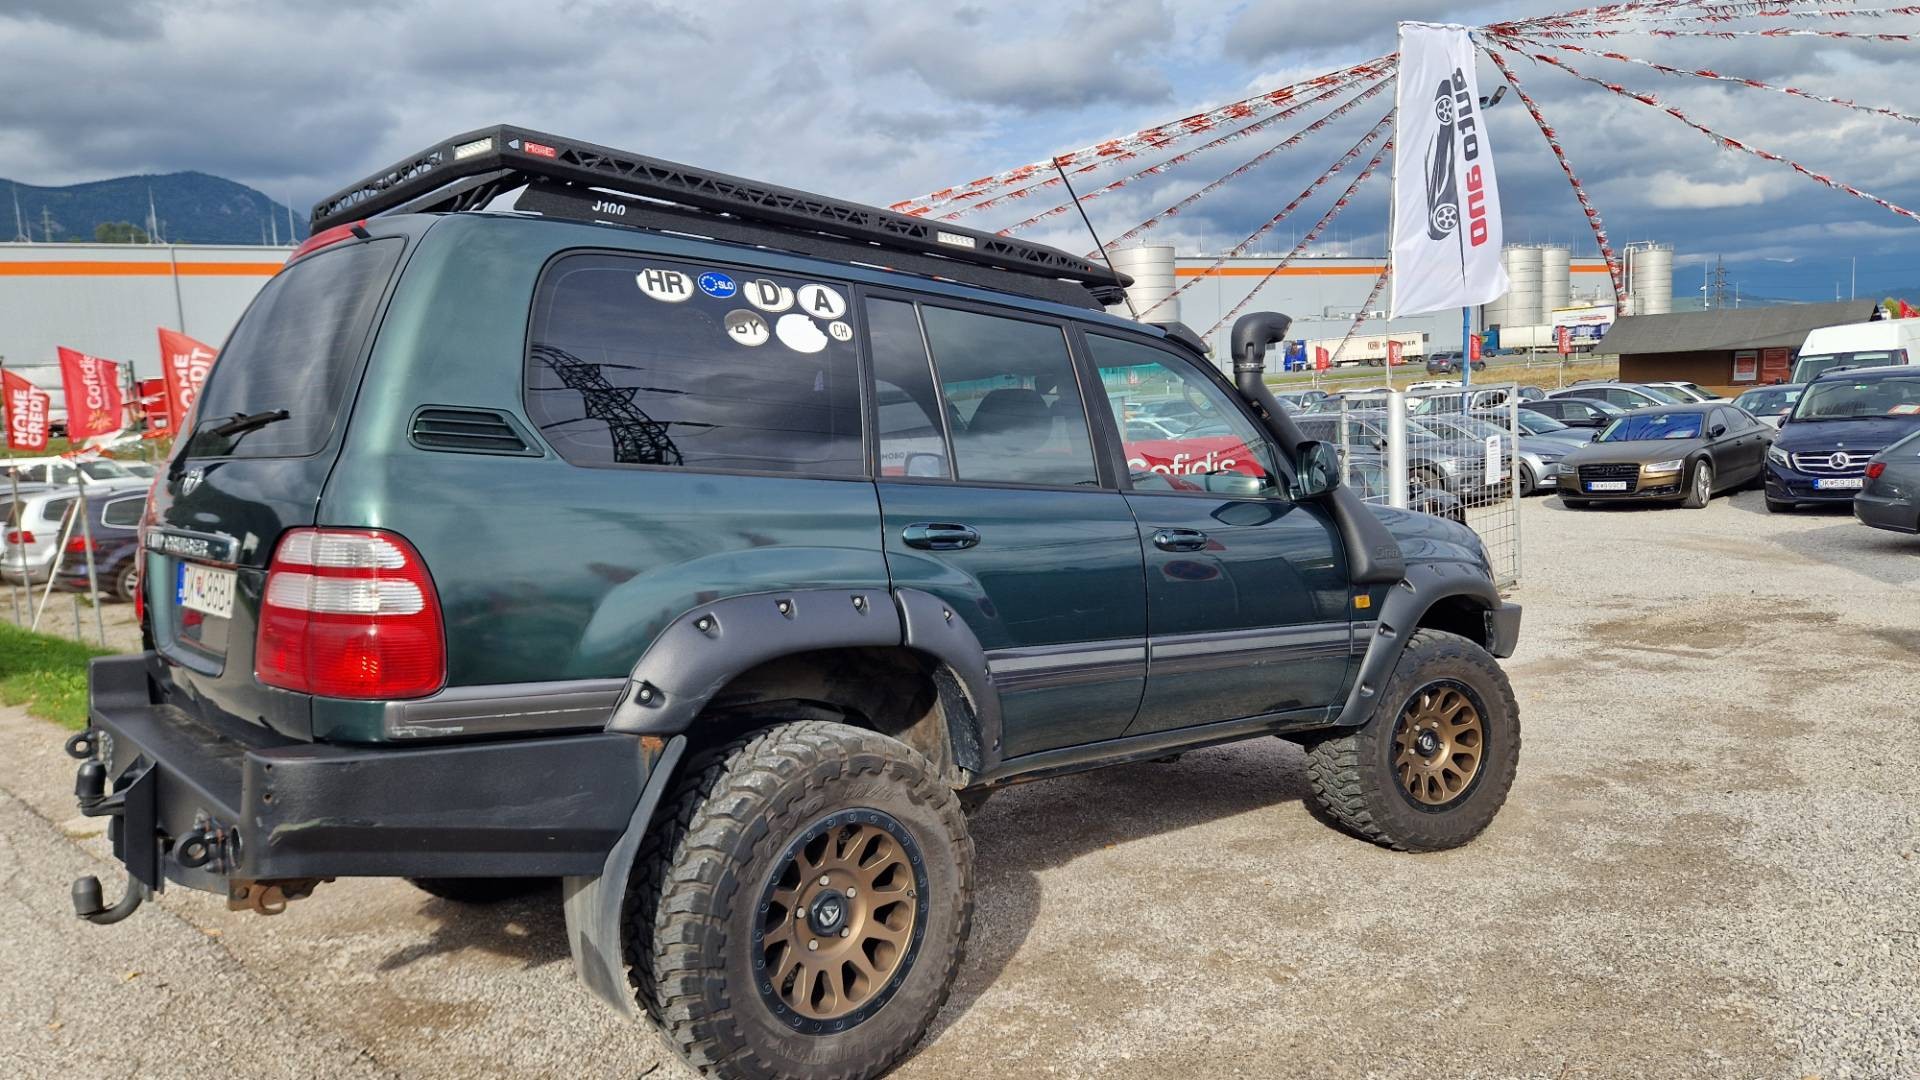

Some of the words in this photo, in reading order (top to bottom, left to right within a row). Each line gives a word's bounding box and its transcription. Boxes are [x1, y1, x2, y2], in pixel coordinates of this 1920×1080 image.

[592, 200, 626, 216] J100
[645, 270, 686, 295] HR
[717, 279, 734, 291] SLO
[757, 280, 781, 306] D
[814, 288, 835, 313] A
[833, 323, 848, 338] CH
[173, 353, 196, 418] OME
[13, 388, 28, 446] HOME
[28, 385, 48, 447] CREDIT
